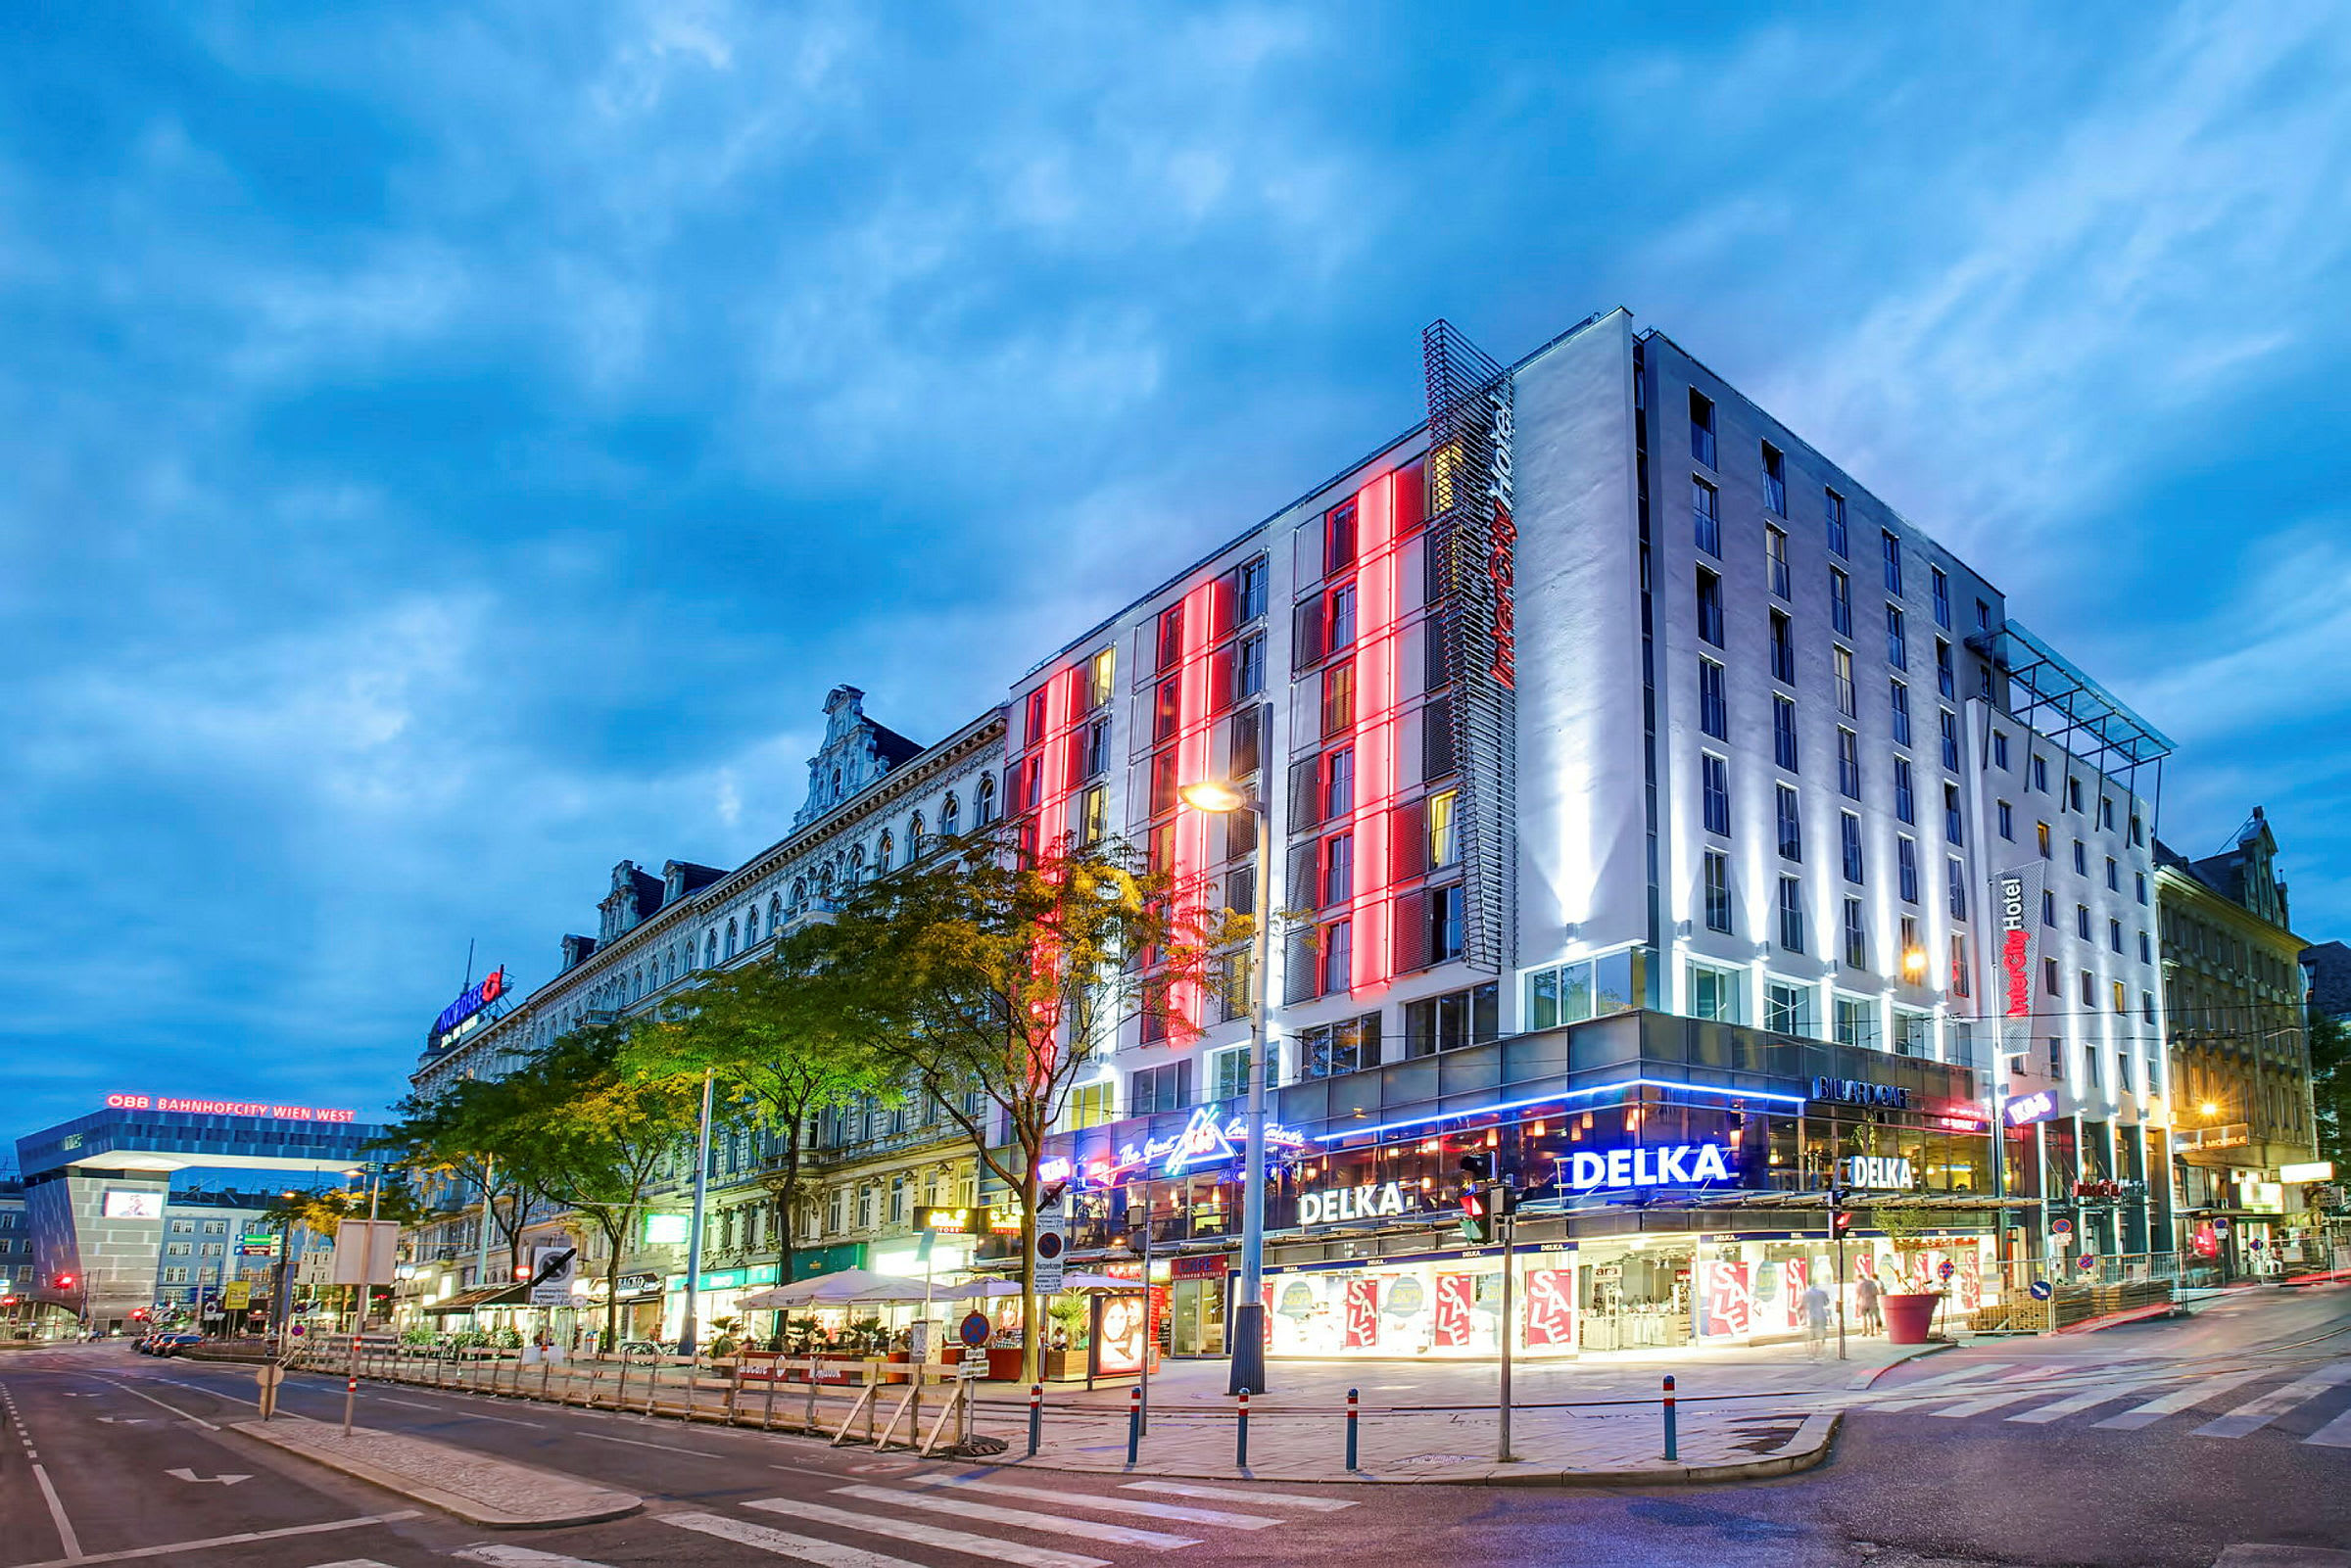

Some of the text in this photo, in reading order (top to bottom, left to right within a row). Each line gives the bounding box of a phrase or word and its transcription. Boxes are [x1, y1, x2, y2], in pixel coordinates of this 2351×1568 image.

[158, 1097, 267, 1117] BAHNHOFCITY
[273, 1106, 312, 1119] WIEN
[316, 1109, 354, 1122] WEST
[1573, 1143, 1728, 1189] DELKA
[1851, 1156, 1913, 1189] DELKA
[1299, 1181, 1405, 1225] DELKA
[1596, 1266, 1617, 1276] ara
[1348, 1281, 1377, 1346] SALE
[1438, 1276, 1469, 1346] SALE
[1530, 1270, 1571, 1344] SALE
[1711, 1262, 1749, 1334] SALE
